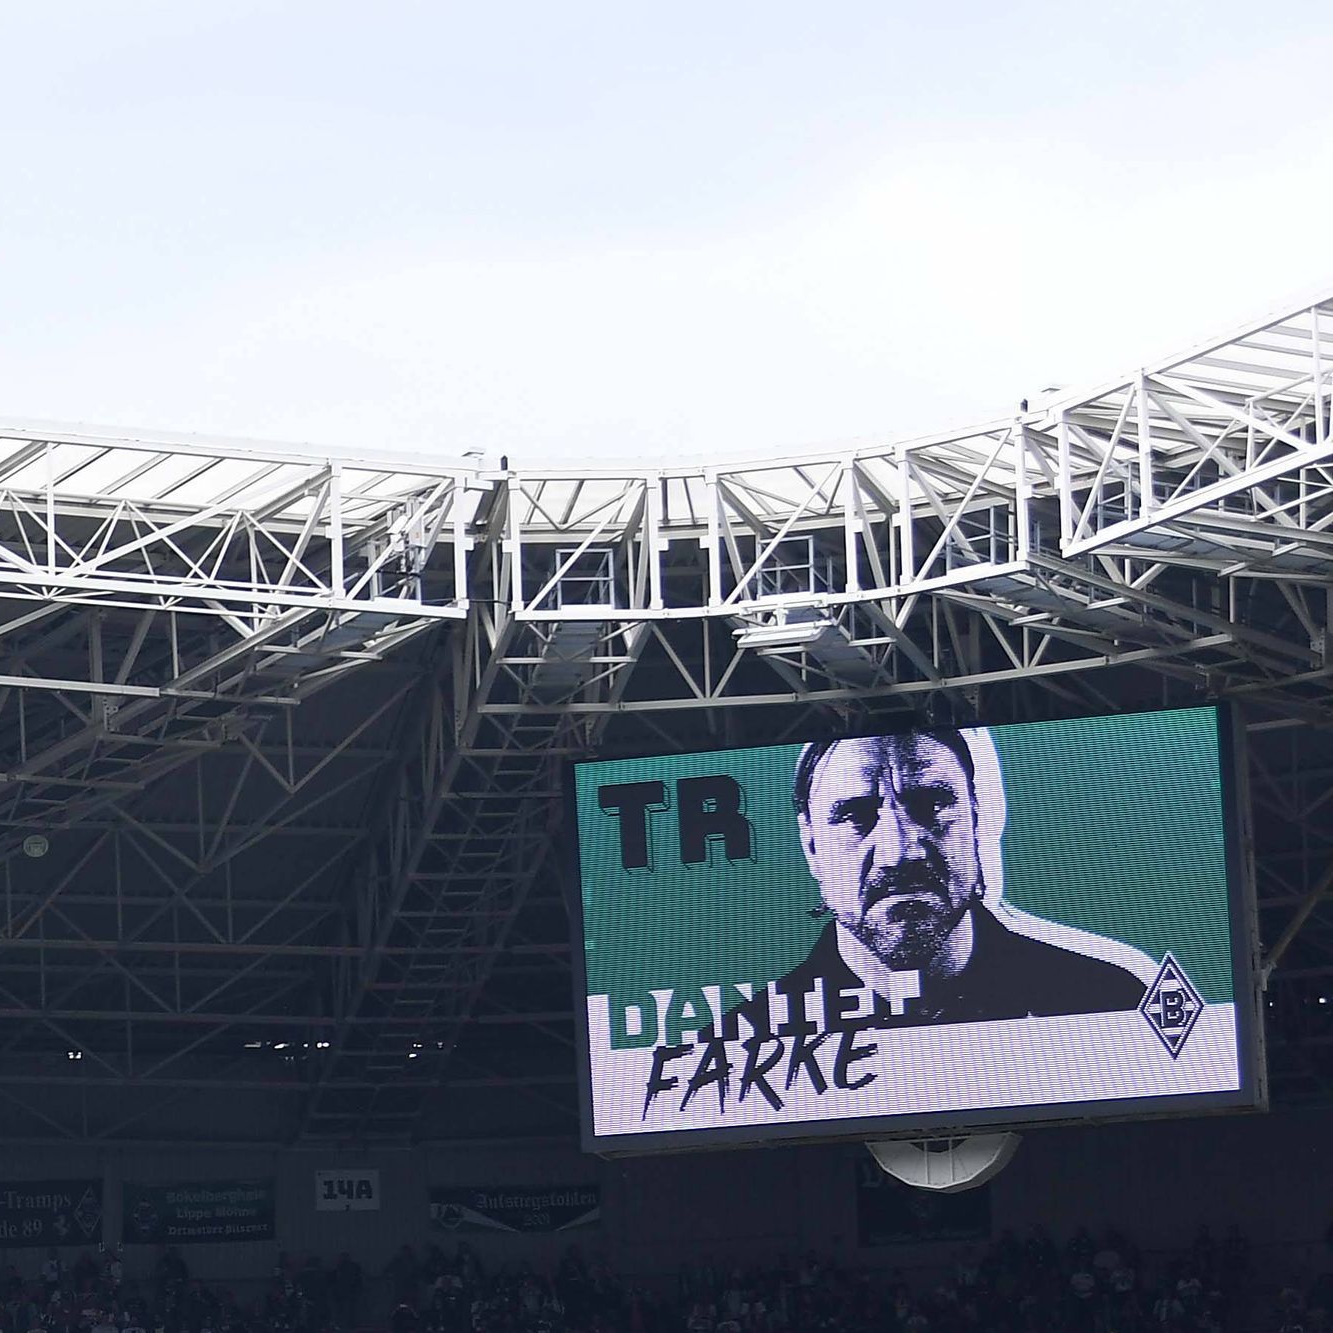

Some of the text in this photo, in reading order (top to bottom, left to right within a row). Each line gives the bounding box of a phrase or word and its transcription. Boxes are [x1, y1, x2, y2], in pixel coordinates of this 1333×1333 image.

[598, 775, 757, 873] TR
[641, 1030, 880, 1122] FARKE
[322, 1179, 374, 1201] 14A
